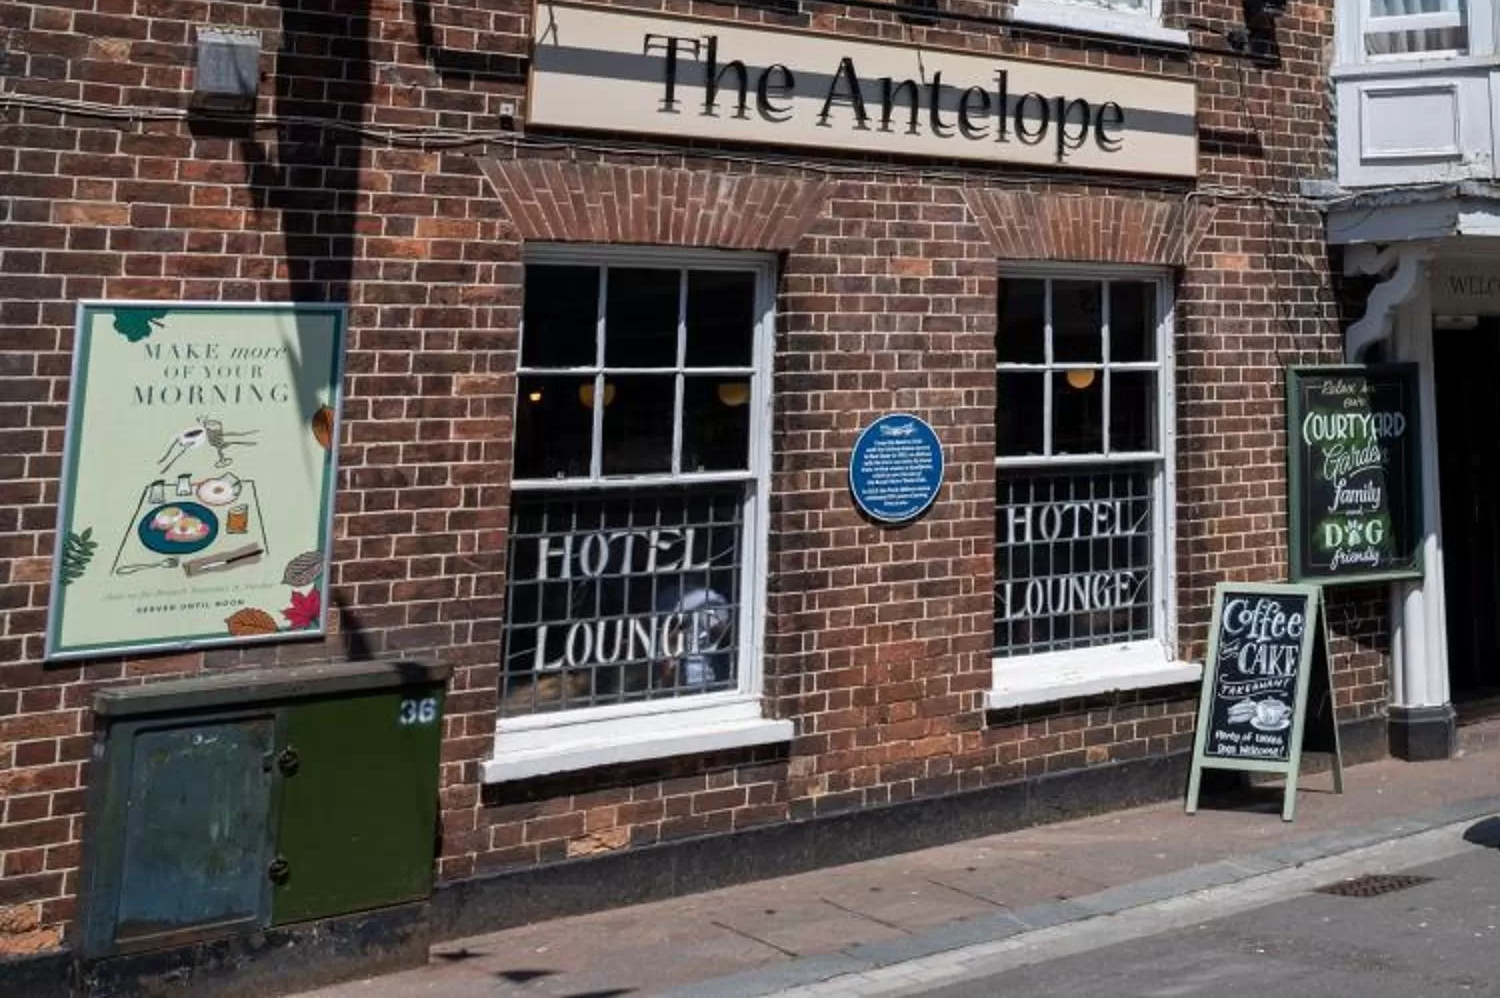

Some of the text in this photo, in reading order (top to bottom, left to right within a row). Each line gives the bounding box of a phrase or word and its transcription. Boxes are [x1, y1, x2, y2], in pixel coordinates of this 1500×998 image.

[643, 33, 1126, 164] The Antelope
[144, 342, 288, 360] MAKE more
[163, 364, 264, 380] OF YOUR
[133, 383, 290, 405] MORNING
[1303, 411, 1407, 446] COURTYARD
[1322, 443, 1390, 482] Garden
[1327, 478, 1382, 514] family
[1007, 501, 1145, 544] HOTEL
[536, 528, 728, 581] HOTEL
[1329, 545, 1381, 571] friendly
[1003, 571, 1144, 620] LOUNGE
[1223, 598, 1304, 643] Coffee
[533, 610, 726, 671] LOUNGE
[1238, 642, 1299, 678] CAKE
[400, 698, 437, 725] 36
